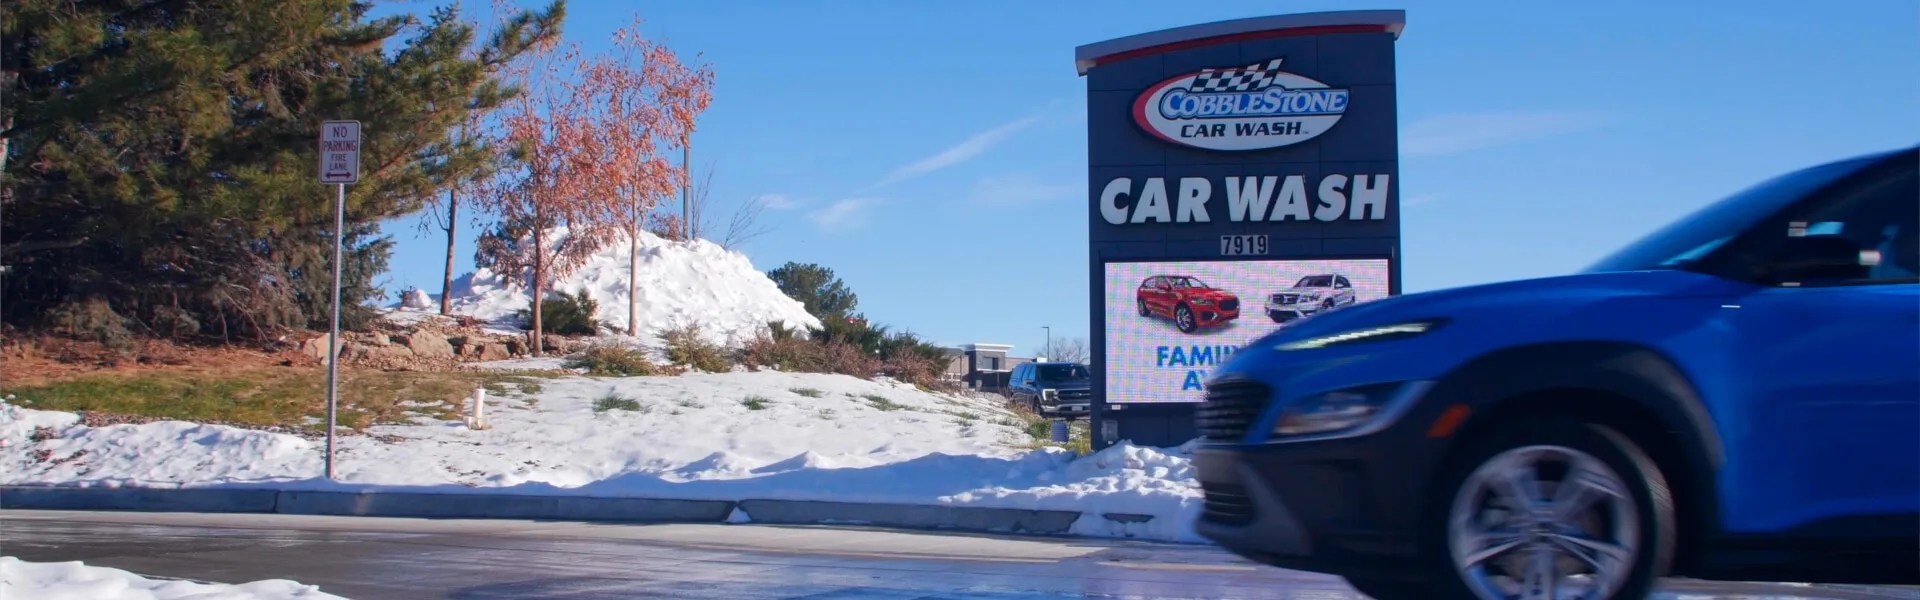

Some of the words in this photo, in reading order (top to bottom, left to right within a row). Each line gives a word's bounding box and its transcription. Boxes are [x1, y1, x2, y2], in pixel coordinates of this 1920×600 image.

[333, 126, 348, 138] NO
[1180, 123, 1227, 138] CAR
[1235, 121, 1302, 137] WASH
[323, 140, 356, 152] PARKING
[331, 153, 347, 162] FIRE
[329, 162, 348, 171] LANE
[1099, 176, 1212, 225] CAR
[1224, 173, 1390, 223] WASH
[1222, 235, 1267, 255] 7919
[1157, 344, 1238, 367] FAMI
